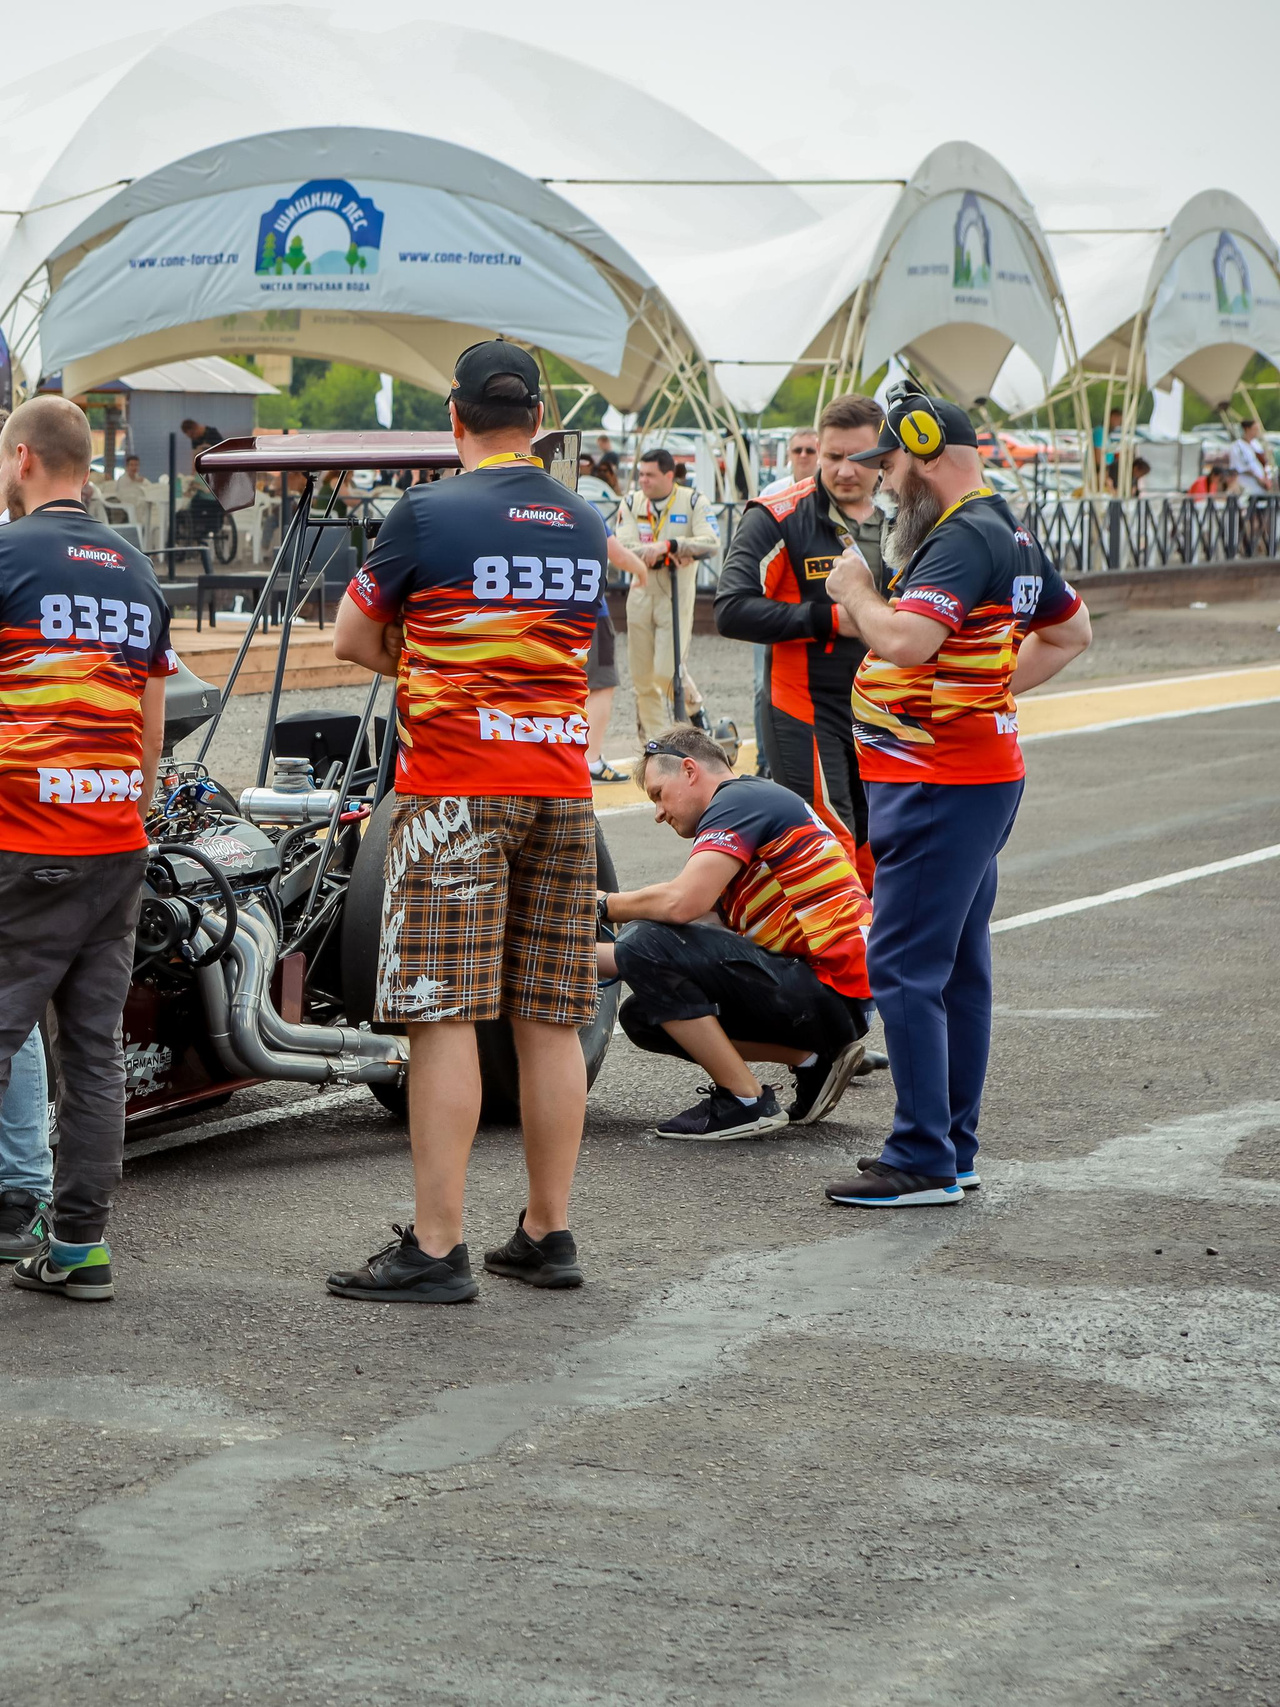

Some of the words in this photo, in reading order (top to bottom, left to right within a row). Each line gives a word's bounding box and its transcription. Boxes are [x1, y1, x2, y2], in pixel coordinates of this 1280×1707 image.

[273, 190, 344, 233] ШИШКИН
[341, 201, 368, 232] ЛЕС
[128, 252, 239, 268] www.cone-forest.ru
[399, 251, 522, 266] www.cone-forest.ru
[346, 282, 371, 292] ВОДА
[473, 556, 602, 603] 8333
[39, 594, 152, 650] 8333
